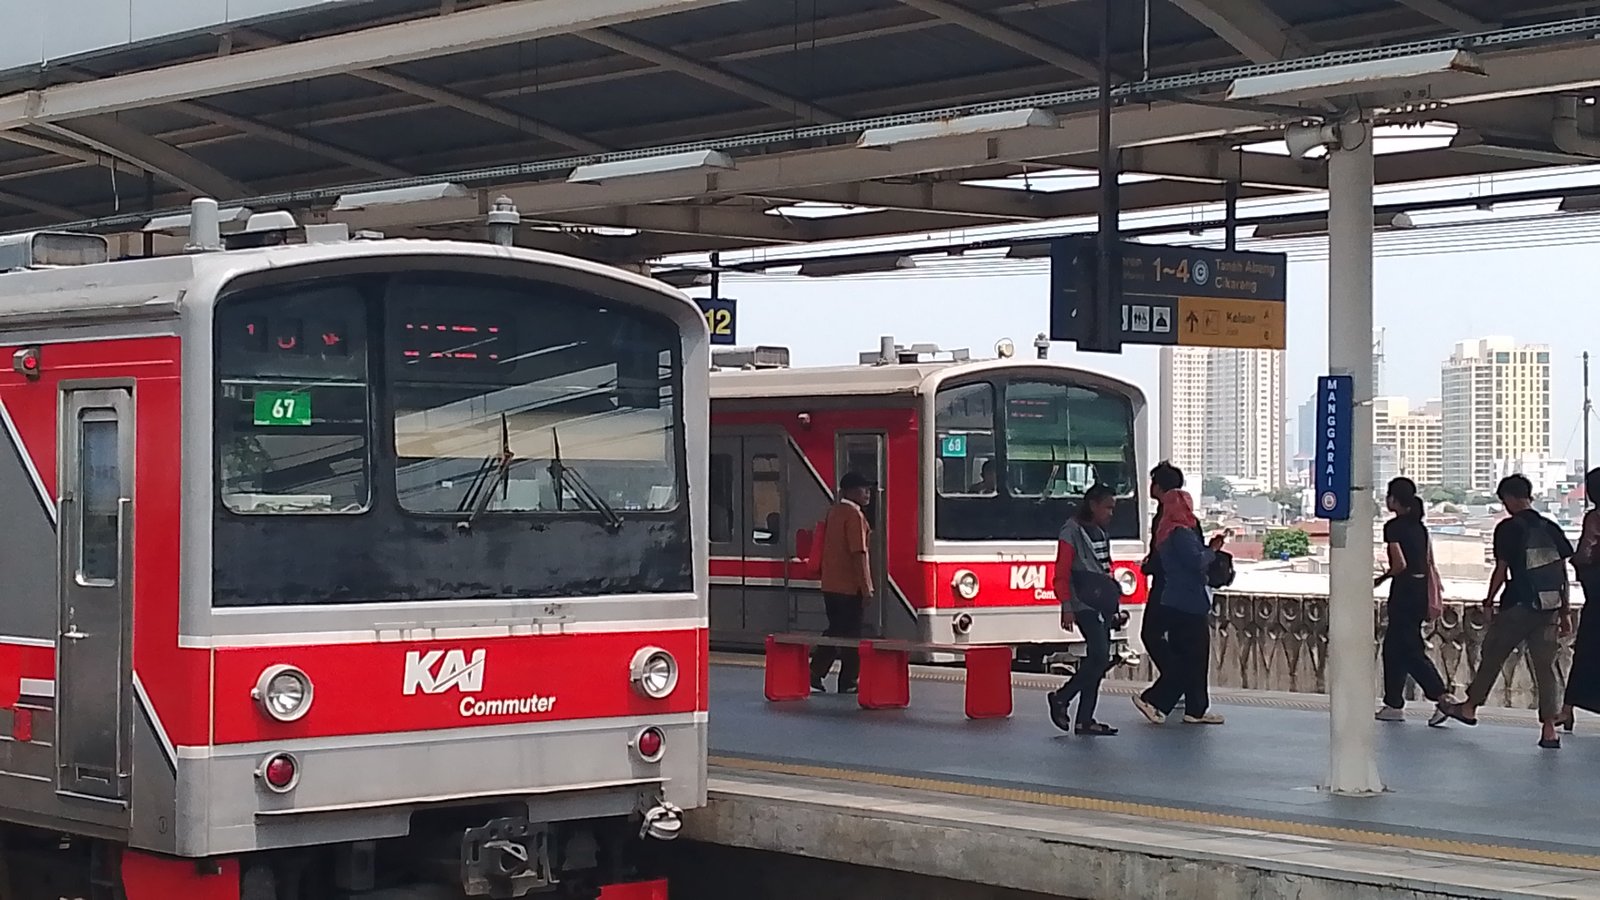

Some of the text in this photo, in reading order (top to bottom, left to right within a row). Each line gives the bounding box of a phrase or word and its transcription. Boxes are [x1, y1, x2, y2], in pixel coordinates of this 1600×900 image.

[1215, 276, 1257, 294] Cikarang
[704, 308, 731, 334] 12
[272, 399, 295, 418] 67
[1326, 379, 1338, 487] MANGGARAI
[1010, 565, 1046, 589] KAI
[403, 648, 487, 695] KAI
[459, 694, 557, 717] Commuter
